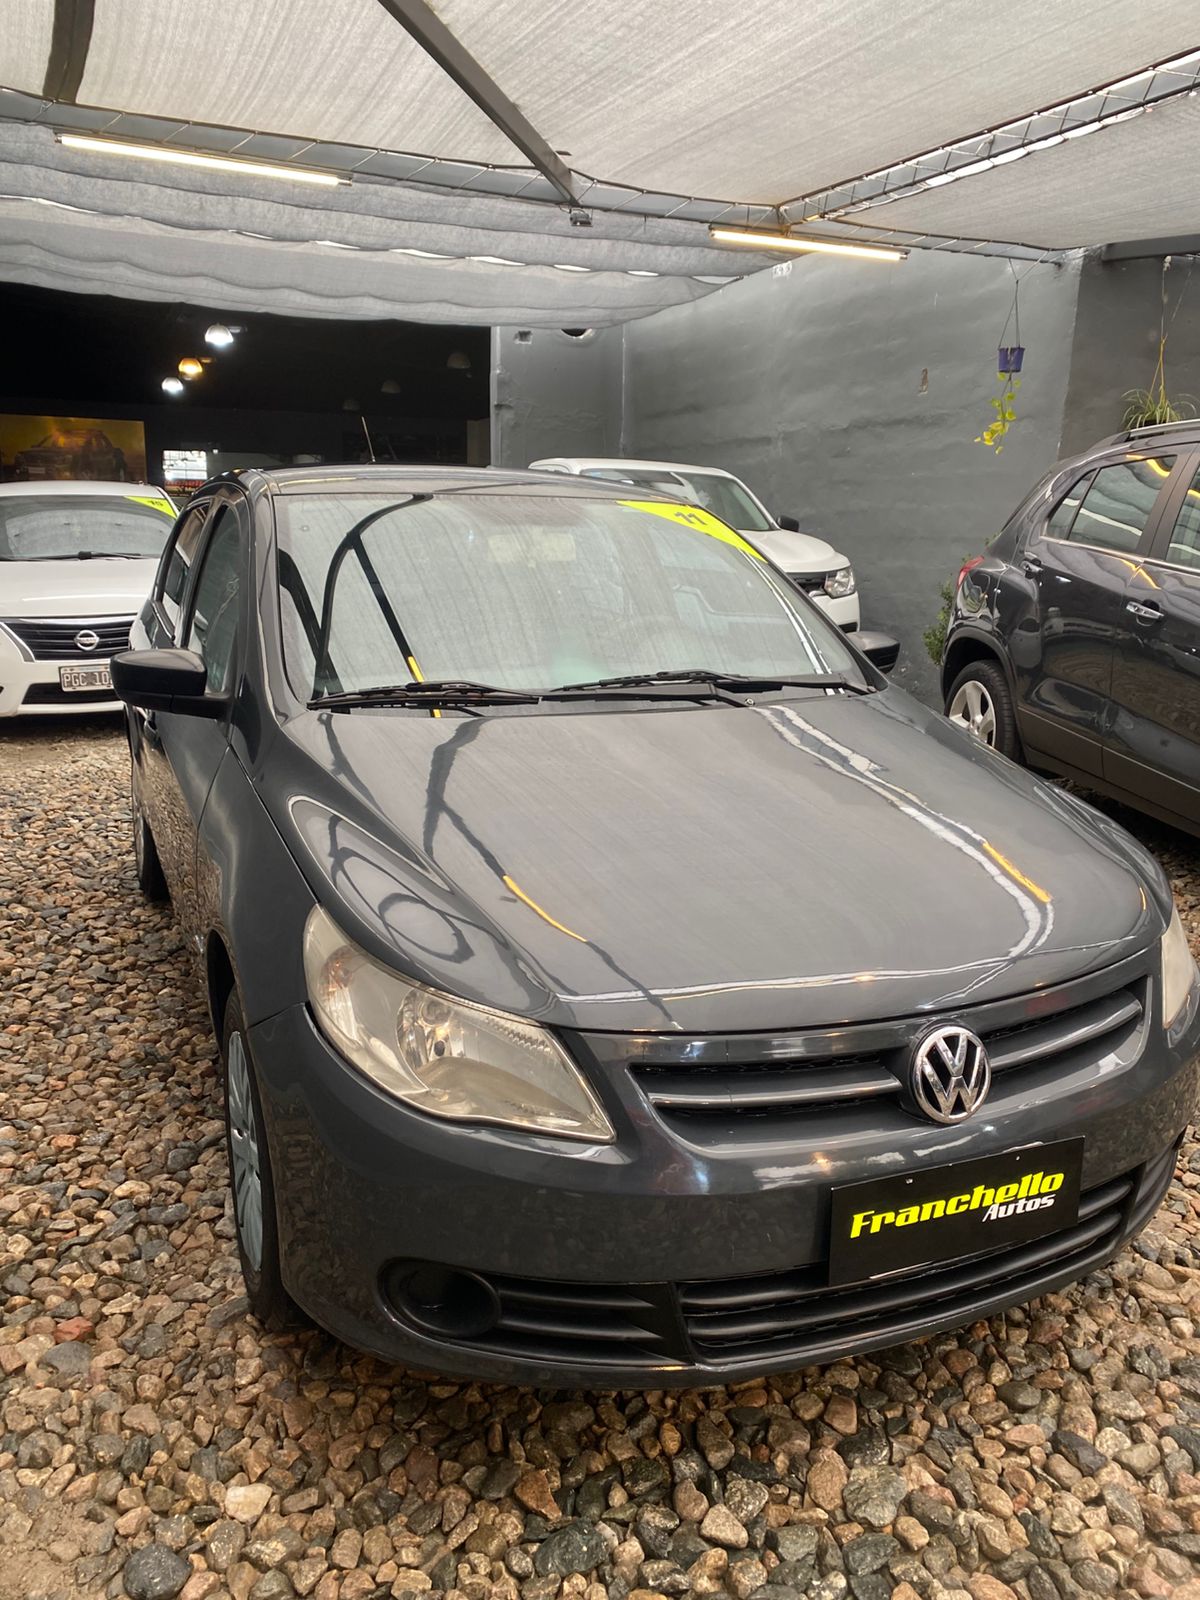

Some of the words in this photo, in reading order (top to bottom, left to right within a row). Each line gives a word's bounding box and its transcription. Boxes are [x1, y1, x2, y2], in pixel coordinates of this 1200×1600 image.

[63, 672, 88, 687] PGC
[94, 671, 113, 686] 10
[851, 1171, 1064, 1238] Franchello
[982, 1194, 1056, 1222] Autos
